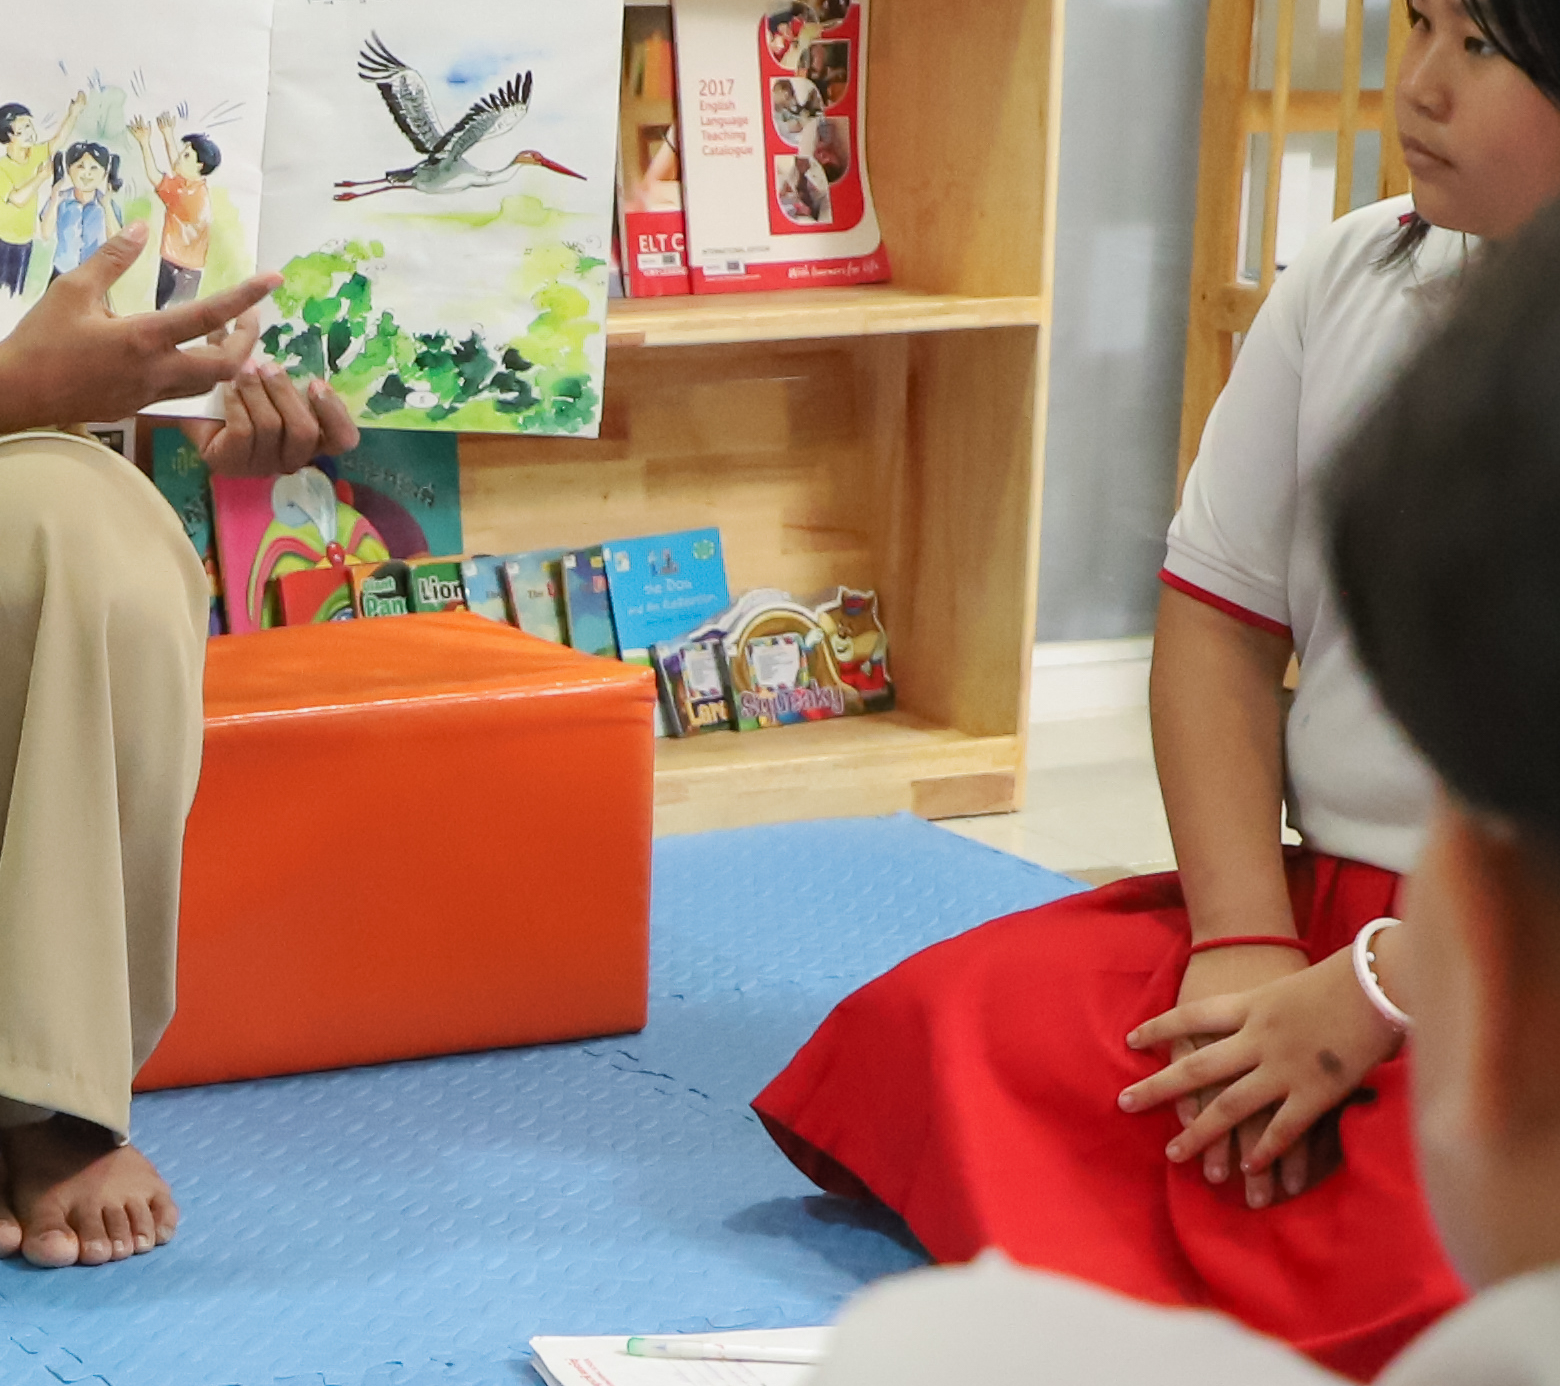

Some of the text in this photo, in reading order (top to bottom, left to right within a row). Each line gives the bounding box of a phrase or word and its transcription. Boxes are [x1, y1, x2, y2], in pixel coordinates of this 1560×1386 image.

[698, 80, 735, 97] 2017
[699, 100, 736, 112] English
[700, 116, 749, 128] Language
[701, 129, 747, 143] Teaching
[702, 144, 754, 157] Catalogue
[638, 234, 667, 253] ELT
[363, 576, 395, 592] Giant
[420, 577, 463, 601] Lion
